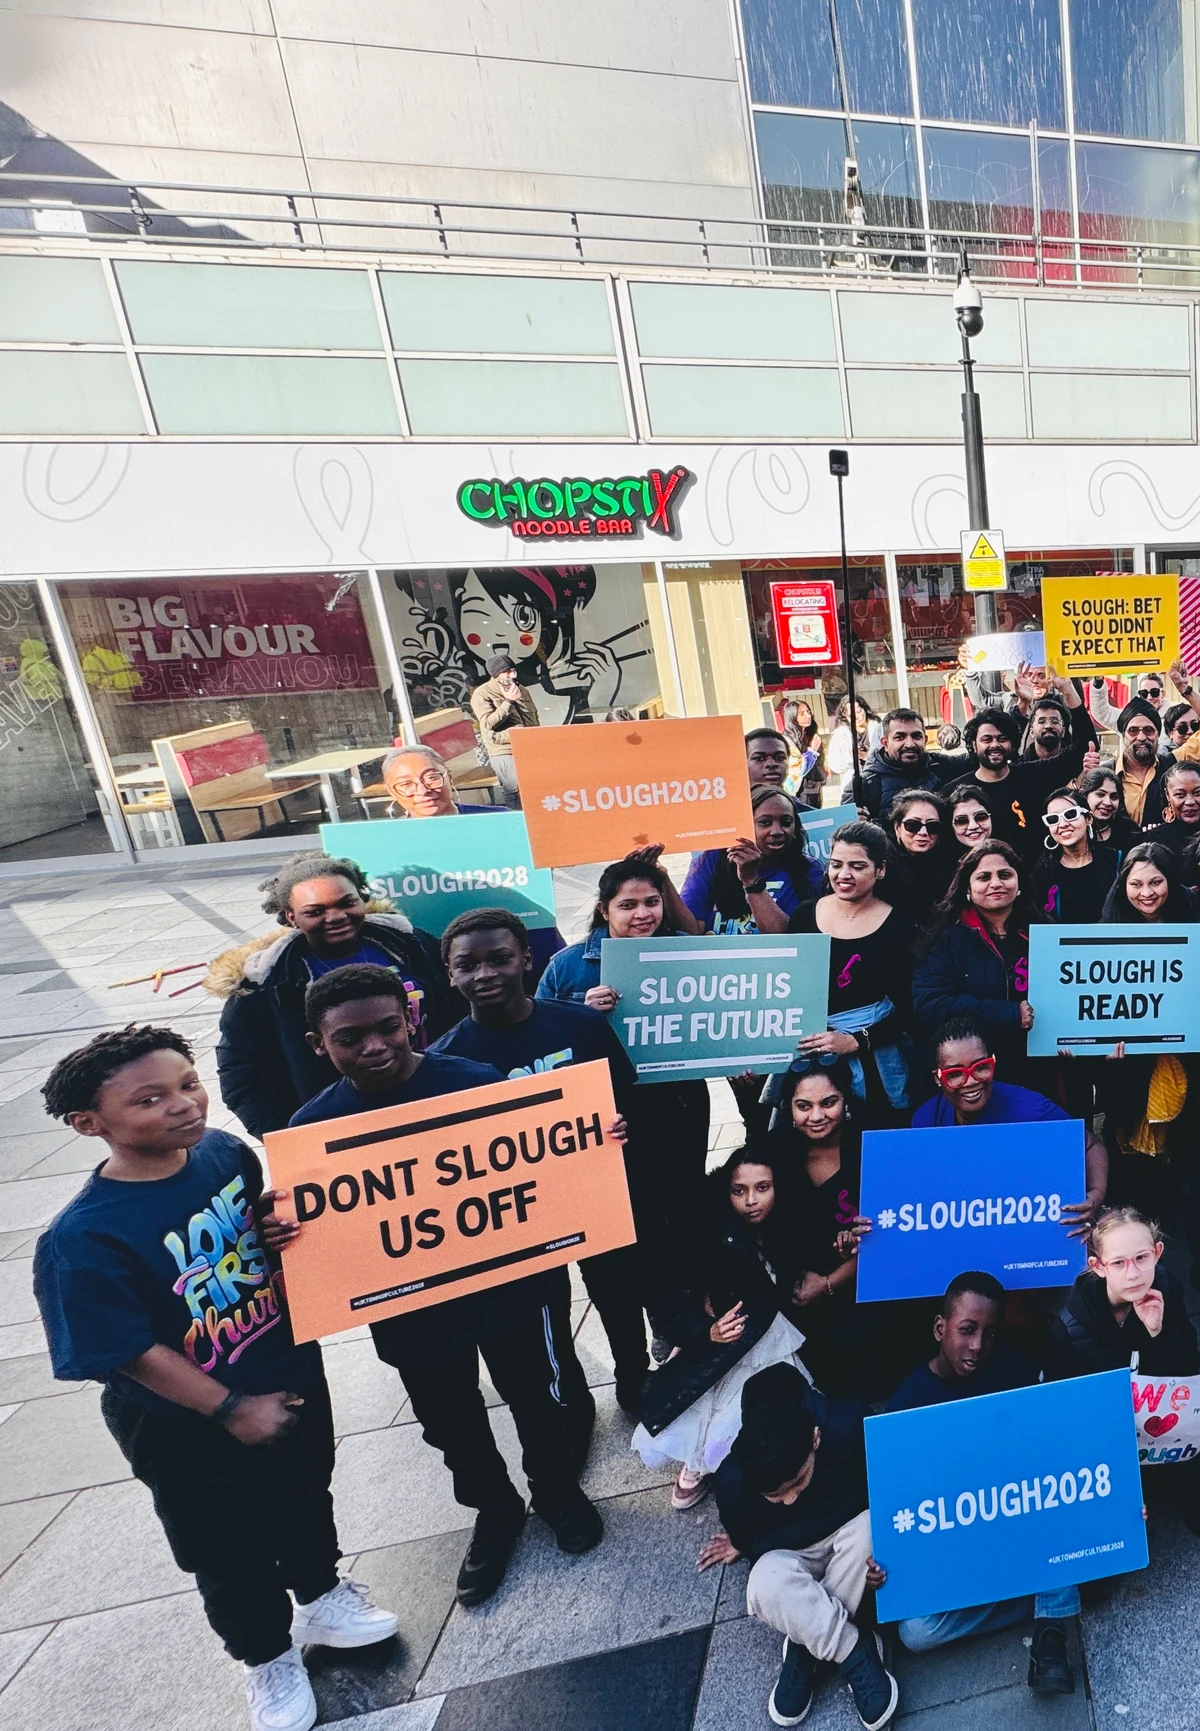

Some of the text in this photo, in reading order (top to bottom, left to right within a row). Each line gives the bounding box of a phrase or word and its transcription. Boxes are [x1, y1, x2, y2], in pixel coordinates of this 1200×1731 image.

[461, 472, 679, 533] CHOPSTIX
[513, 518, 633, 536] NOODLE BAR
[104, 595, 188, 630] BIG
[783, 597, 825, 606] RELOCATING
[1062, 597, 1162, 617] SLOUGH: BET
[115, 623, 321, 663] FLAVOUR
[1071, 617, 1154, 637] YOU DIDNT
[1061, 637, 1123, 656] EXPECT
[1133, 636, 1166, 652] THAT
[541, 776, 727, 814] #SLOUGH2028
[362, 865, 529, 899] SLOUGH2028
[638, 972, 792, 1005] SLOUGH IS
[1059, 959, 1184, 985] SLOUGH IS
[1077, 993, 1165, 1021] READY
[623, 1007, 803, 1047] THE FUTURE
[293, 1112, 604, 1224] DONT SLOUGH
[163, 1174, 254, 1274] LOVE
[379, 1180, 539, 1260] US OFF
[877, 1193, 1062, 1232] #SLOUGH2028
[172, 1230, 270, 1321] FIRS
[184, 1288, 279, 1374] Chur
[1131, 1381, 1191, 1414] We
[1138, 1443, 1198, 1463] ough
[892, 1463, 1112, 1534] #SLOUGH2028
[1048, 1540, 1125, 1564] #UKTOWNOFCULTURE2028
